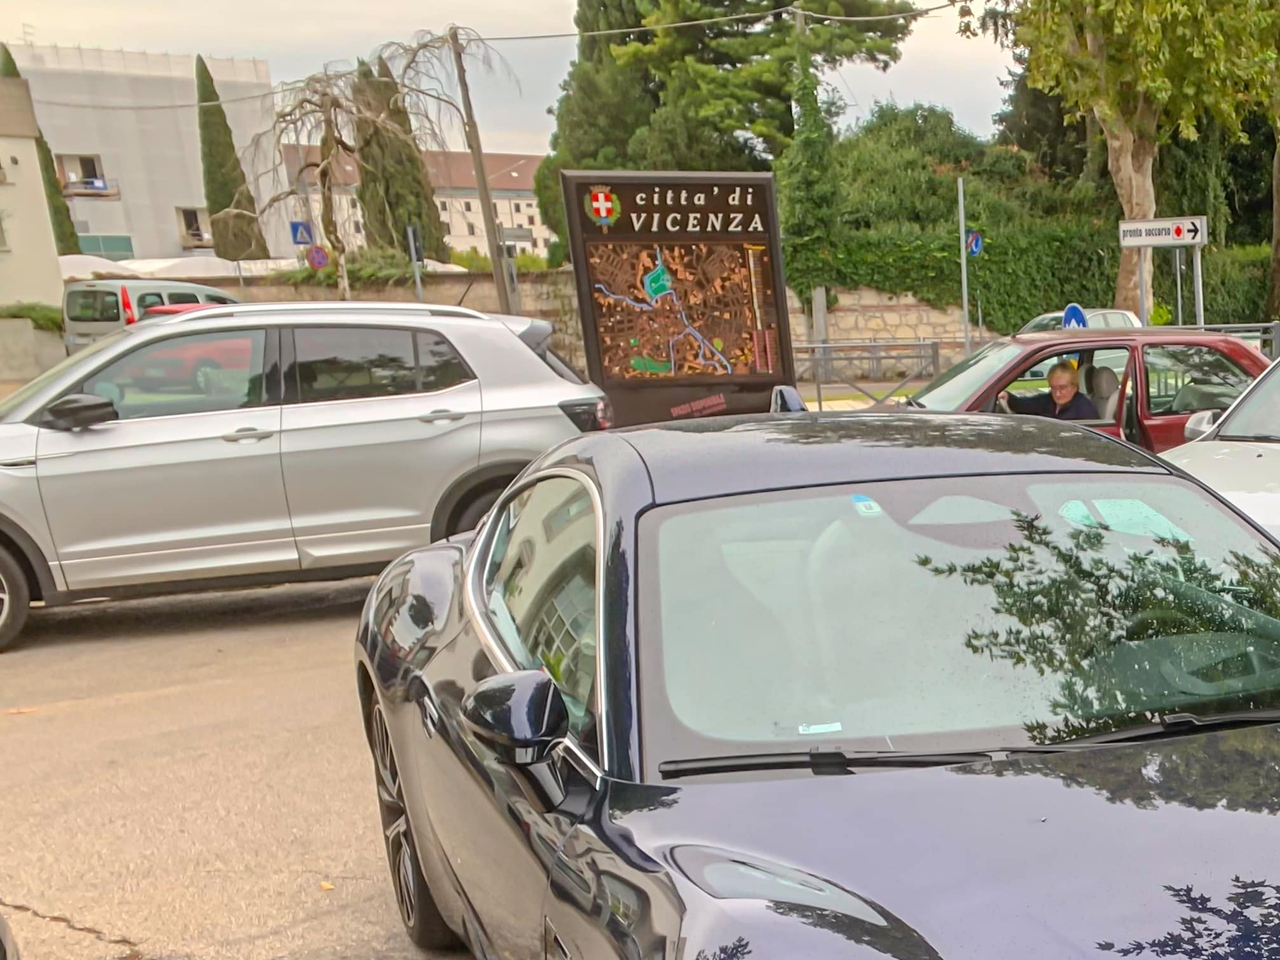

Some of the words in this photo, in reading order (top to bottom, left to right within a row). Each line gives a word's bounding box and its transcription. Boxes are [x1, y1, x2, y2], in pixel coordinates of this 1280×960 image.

[630, 213, 764, 232] VICENZA
[1122, 228, 1143, 241] pronto
[1145, 227, 1171, 237] soccorso
